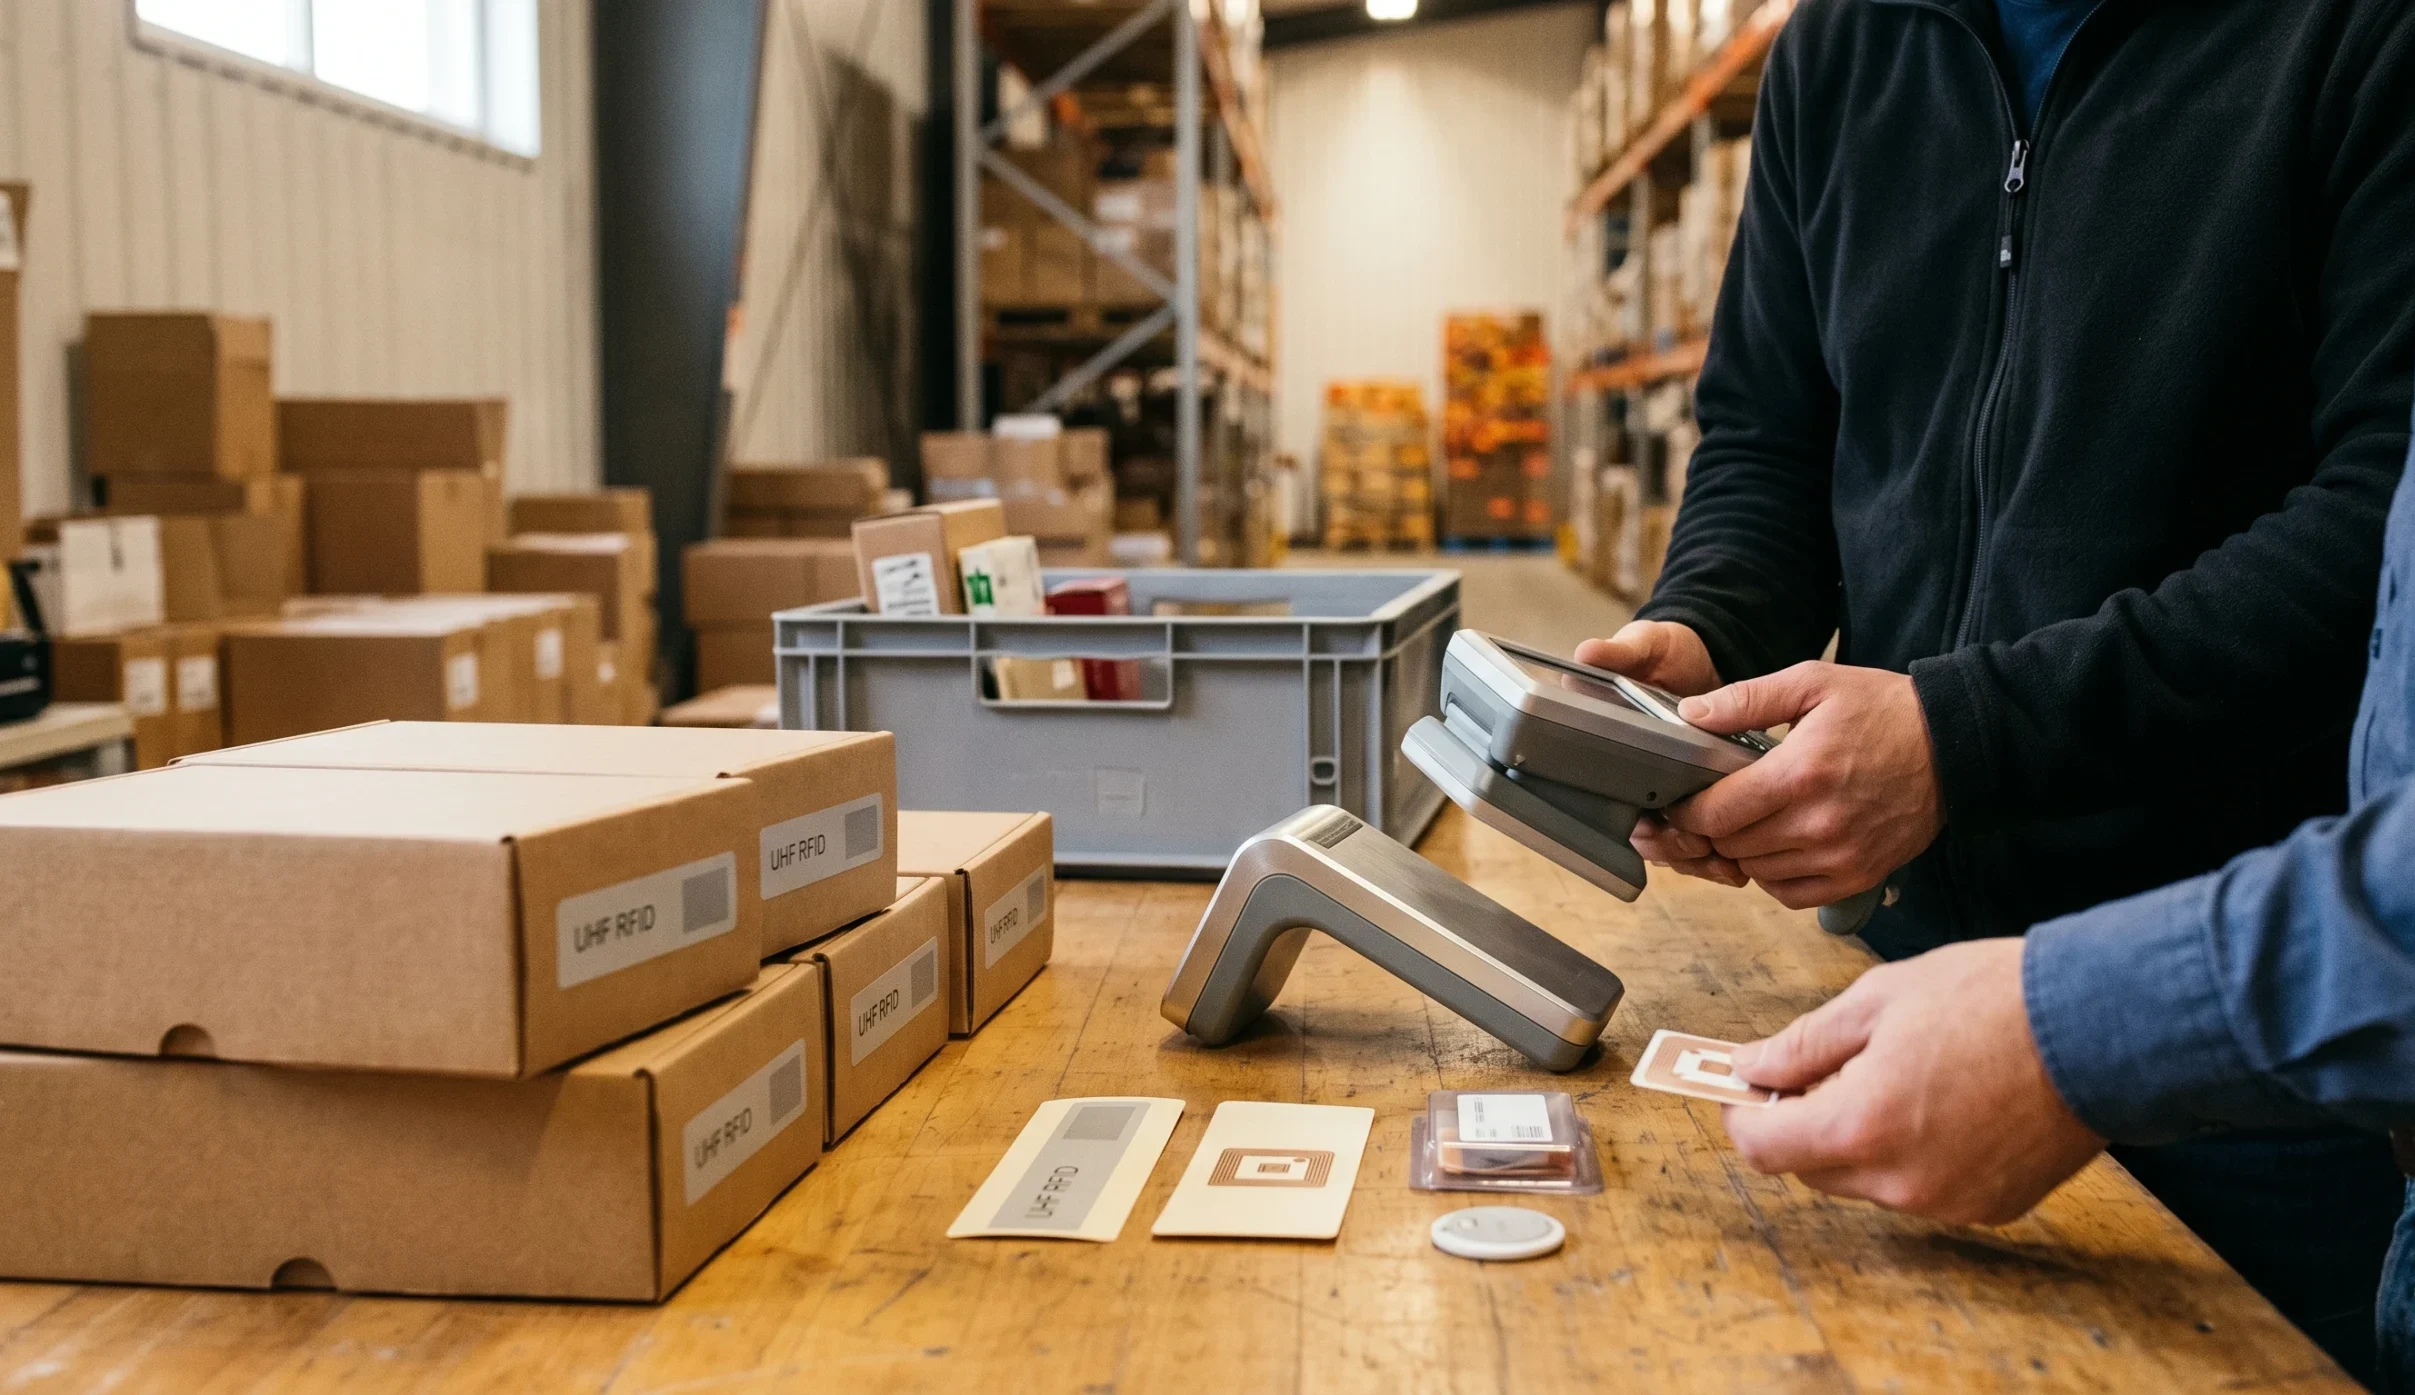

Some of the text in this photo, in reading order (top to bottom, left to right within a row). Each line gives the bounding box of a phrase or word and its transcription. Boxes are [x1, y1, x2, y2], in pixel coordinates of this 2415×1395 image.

[771, 834, 826, 871] UHF RFID
[573, 904, 656, 953] UHF RFID
[989, 907, 1018, 944] UHF RFID
[858, 988, 900, 1037] UHF RFID
[693, 1107, 753, 1170] UHF RFID
[1025, 1166, 1079, 1220] UHF RFID
